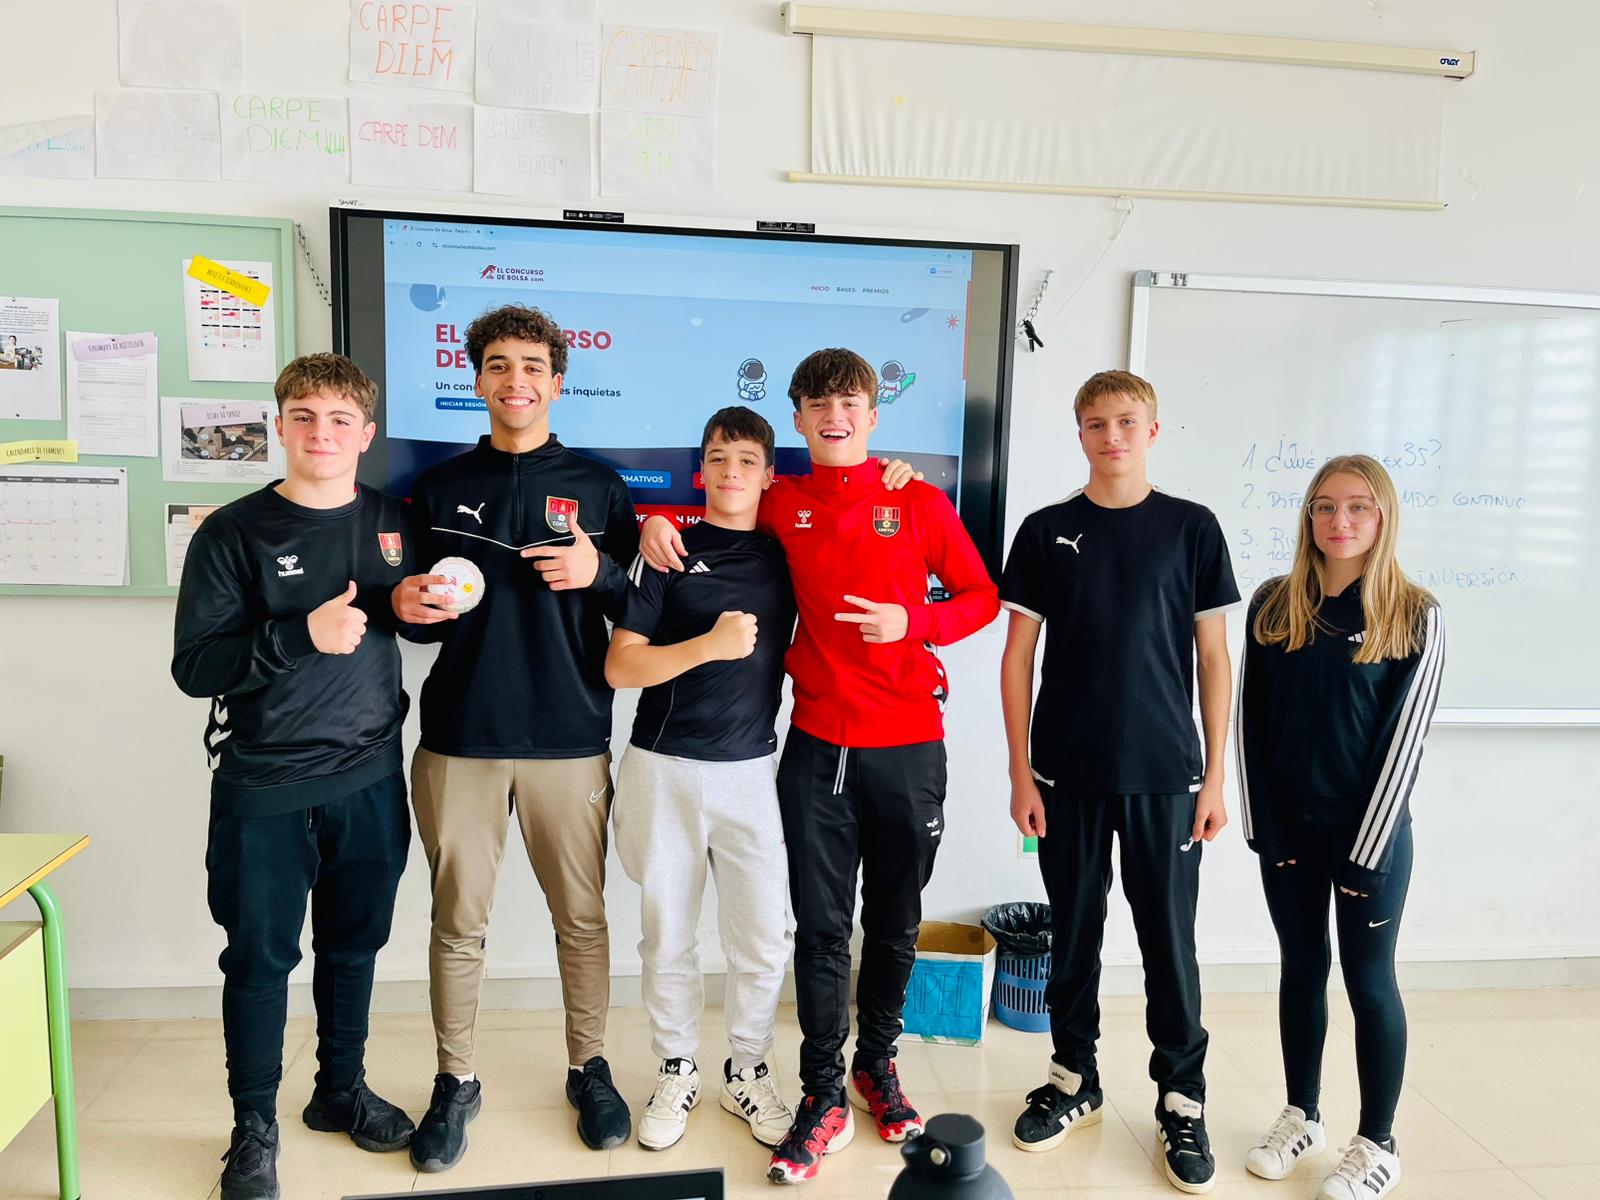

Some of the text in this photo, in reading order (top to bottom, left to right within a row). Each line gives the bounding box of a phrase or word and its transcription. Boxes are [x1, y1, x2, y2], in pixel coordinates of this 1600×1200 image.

[360, 1, 453, 44] CARPE
[375, 40, 453, 81] DIEM
[233, 95, 321, 121] CARPE
[359, 121, 408, 147] CARPE
[435, 323, 461, 344] EL
[435, 349, 467, 368] DE
[435, 381, 451, 391] Un
[572, 386, 621, 398] inquietas
